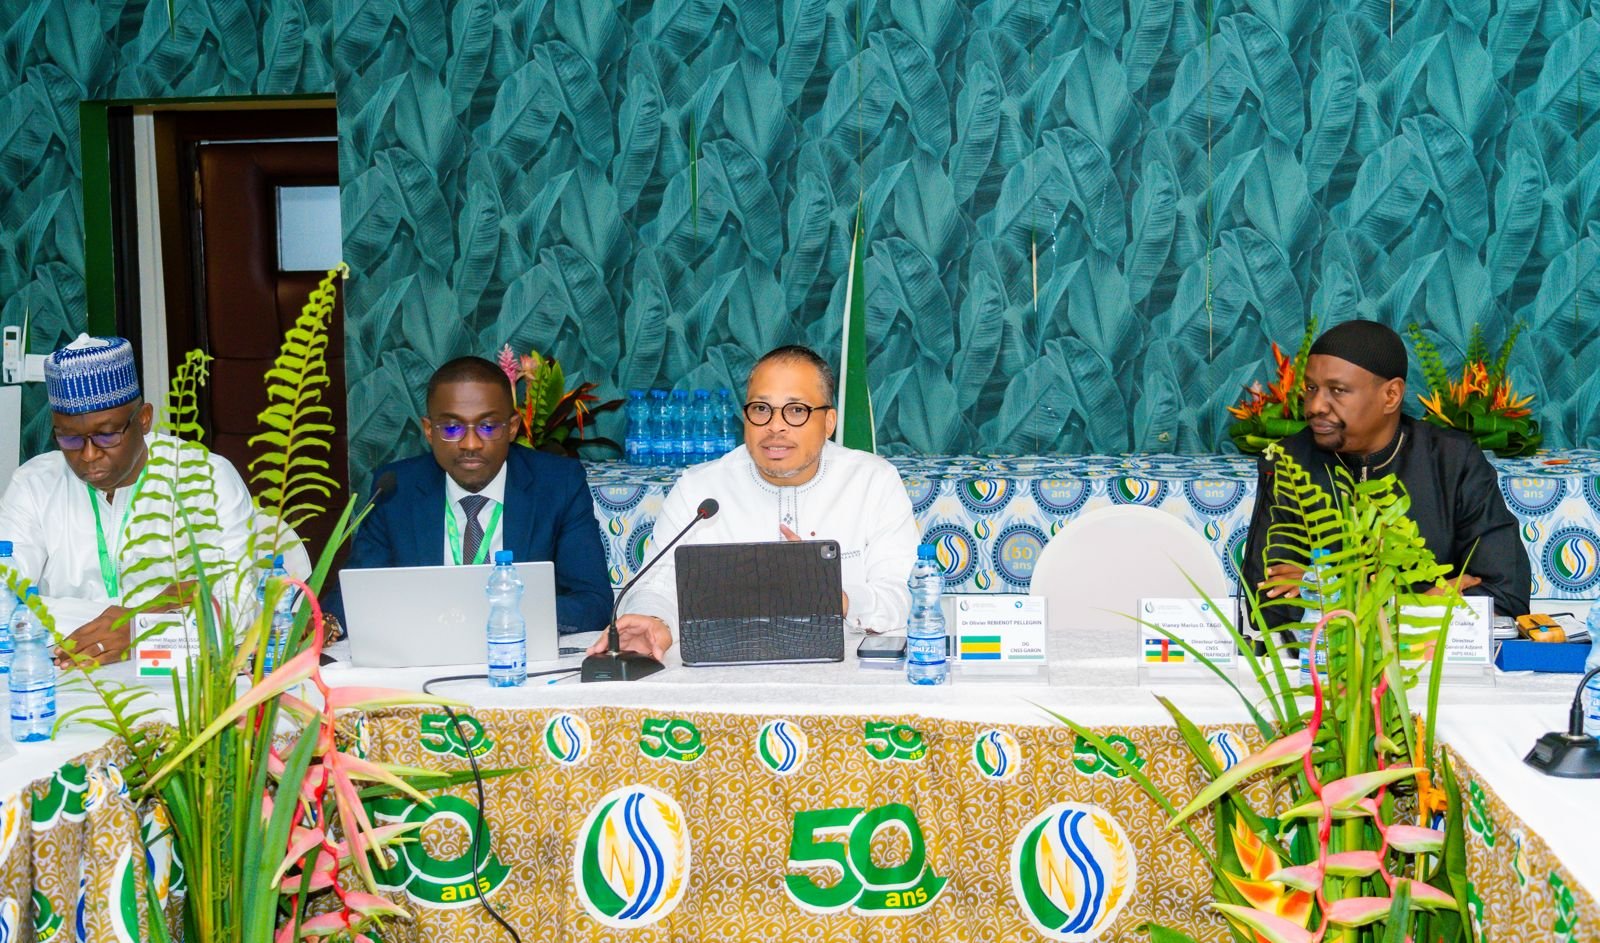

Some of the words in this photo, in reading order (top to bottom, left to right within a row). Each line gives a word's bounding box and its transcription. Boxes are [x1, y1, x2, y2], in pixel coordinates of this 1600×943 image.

[1523, 490, 1545, 499] ans
[1012, 562, 1032, 570] ans
[420, 713, 485, 753] 50
[639, 718, 701, 758] 50
[864, 721, 922, 760] 50
[681, 751, 699, 761] ans
[1072, 735, 1137, 774] 50
[783, 803, 927, 908] 50
[440, 876, 491, 901] ans
[884, 886, 928, 907] ans
